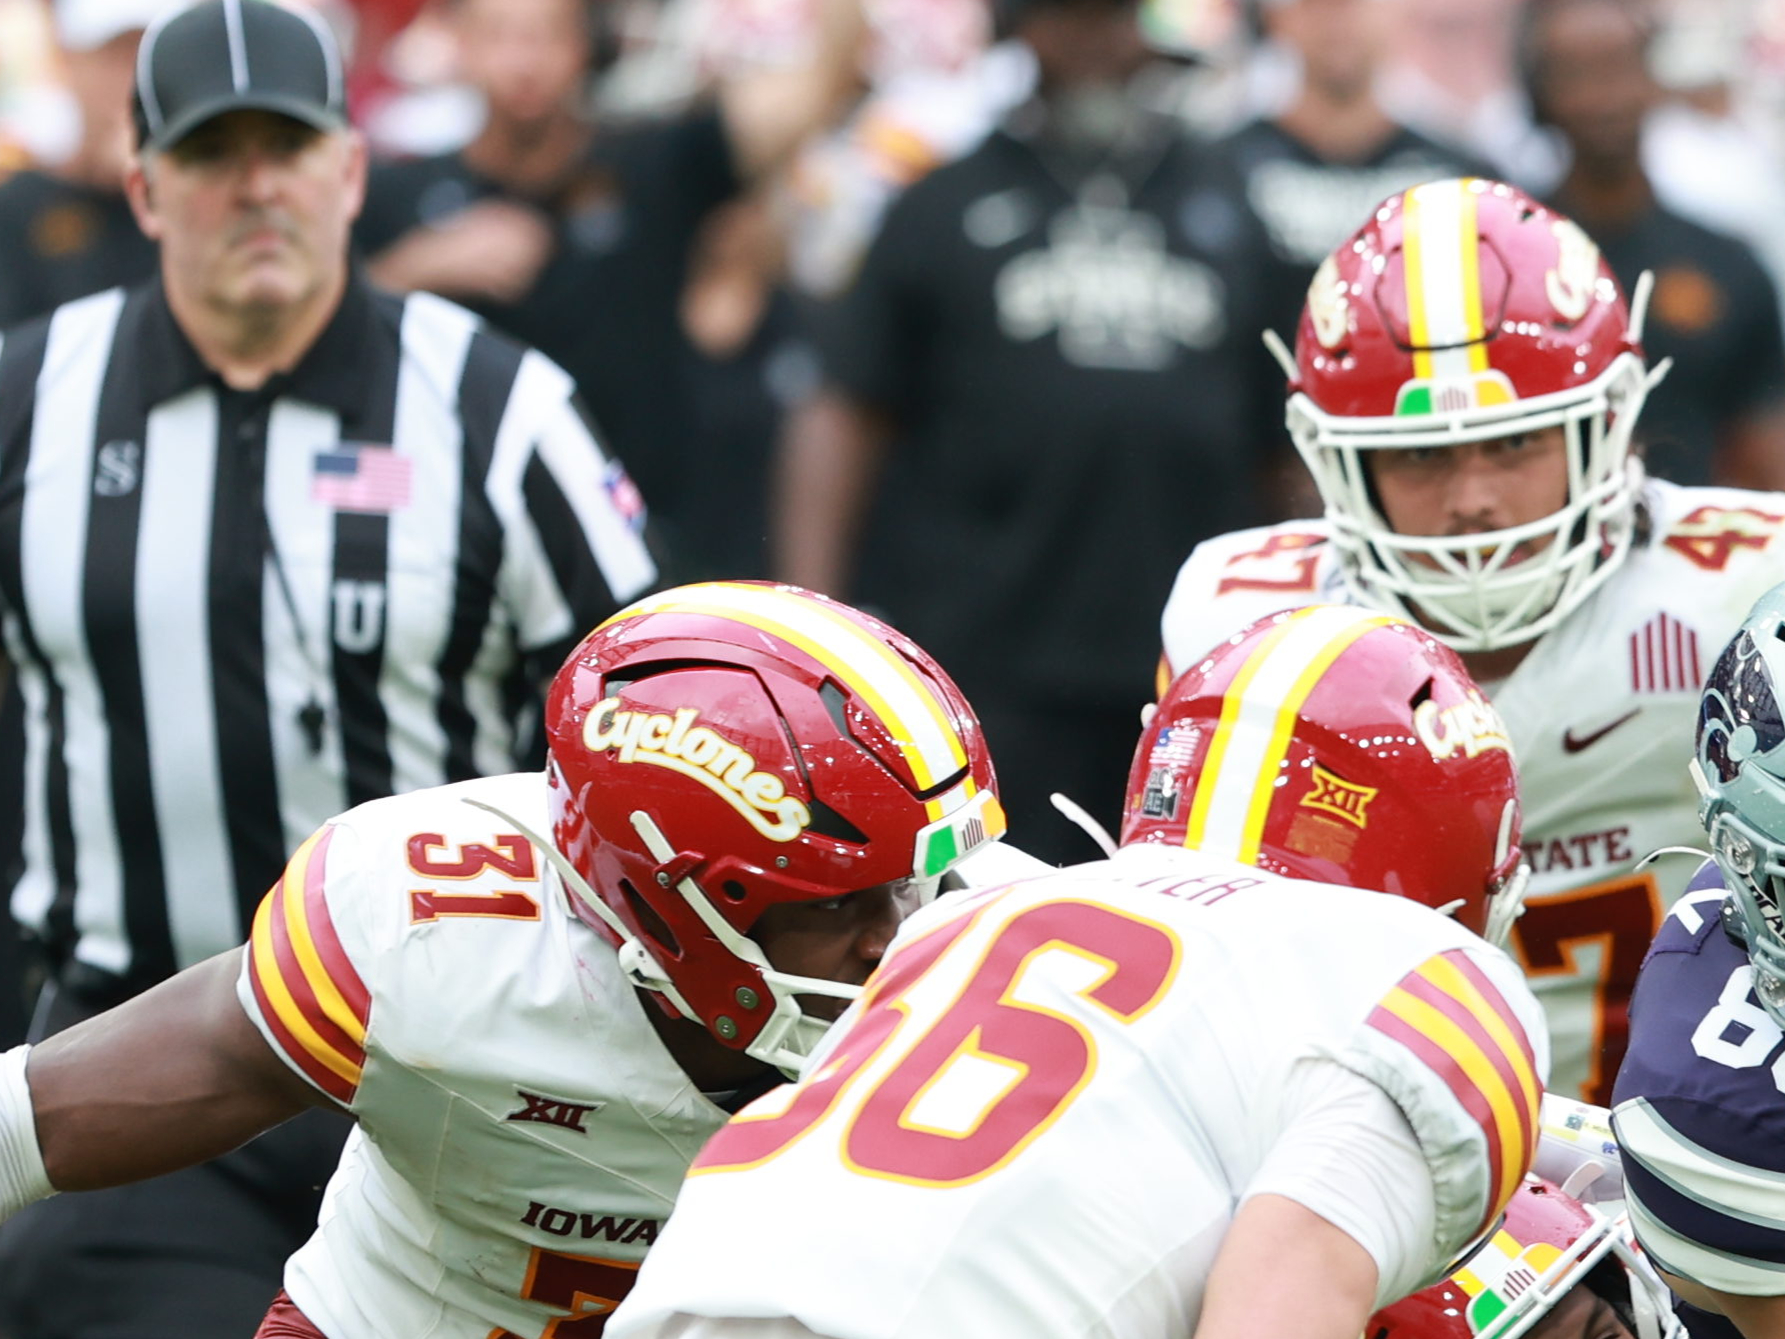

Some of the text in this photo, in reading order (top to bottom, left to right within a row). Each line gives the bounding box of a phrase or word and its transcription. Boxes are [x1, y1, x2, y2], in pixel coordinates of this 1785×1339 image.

[333, 579, 387, 655] U
[583, 697, 811, 843] Cyclones
[404, 832, 542, 925] 31
[1521, 823, 1633, 875] TATE
[1510, 870, 1664, 1110] 7
[520, 1200, 658, 1247] IOWA
